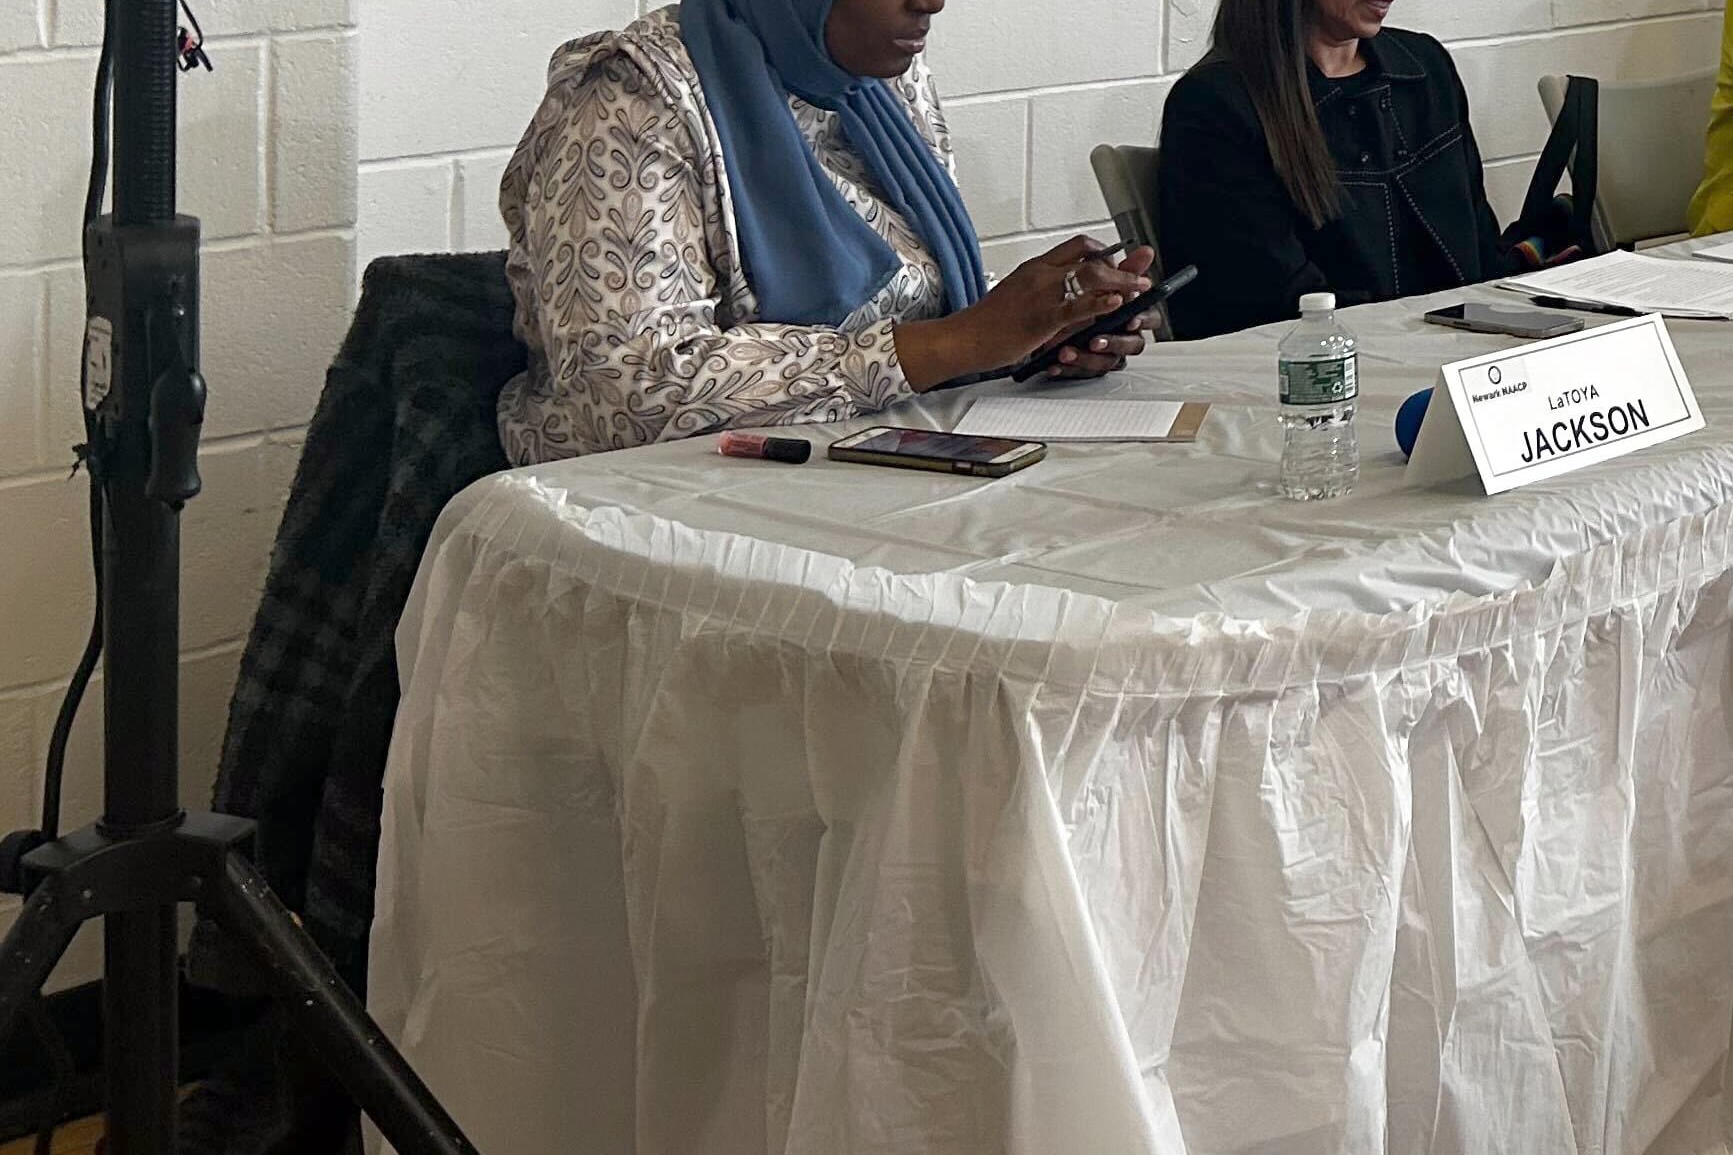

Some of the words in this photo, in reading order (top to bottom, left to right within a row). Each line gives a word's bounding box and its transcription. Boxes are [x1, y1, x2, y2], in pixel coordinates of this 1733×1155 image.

[1502, 381, 1528, 396] NAACP
[1548, 384, 1600, 411] LaTOYA
[1521, 398, 1650, 463] JACKSON
